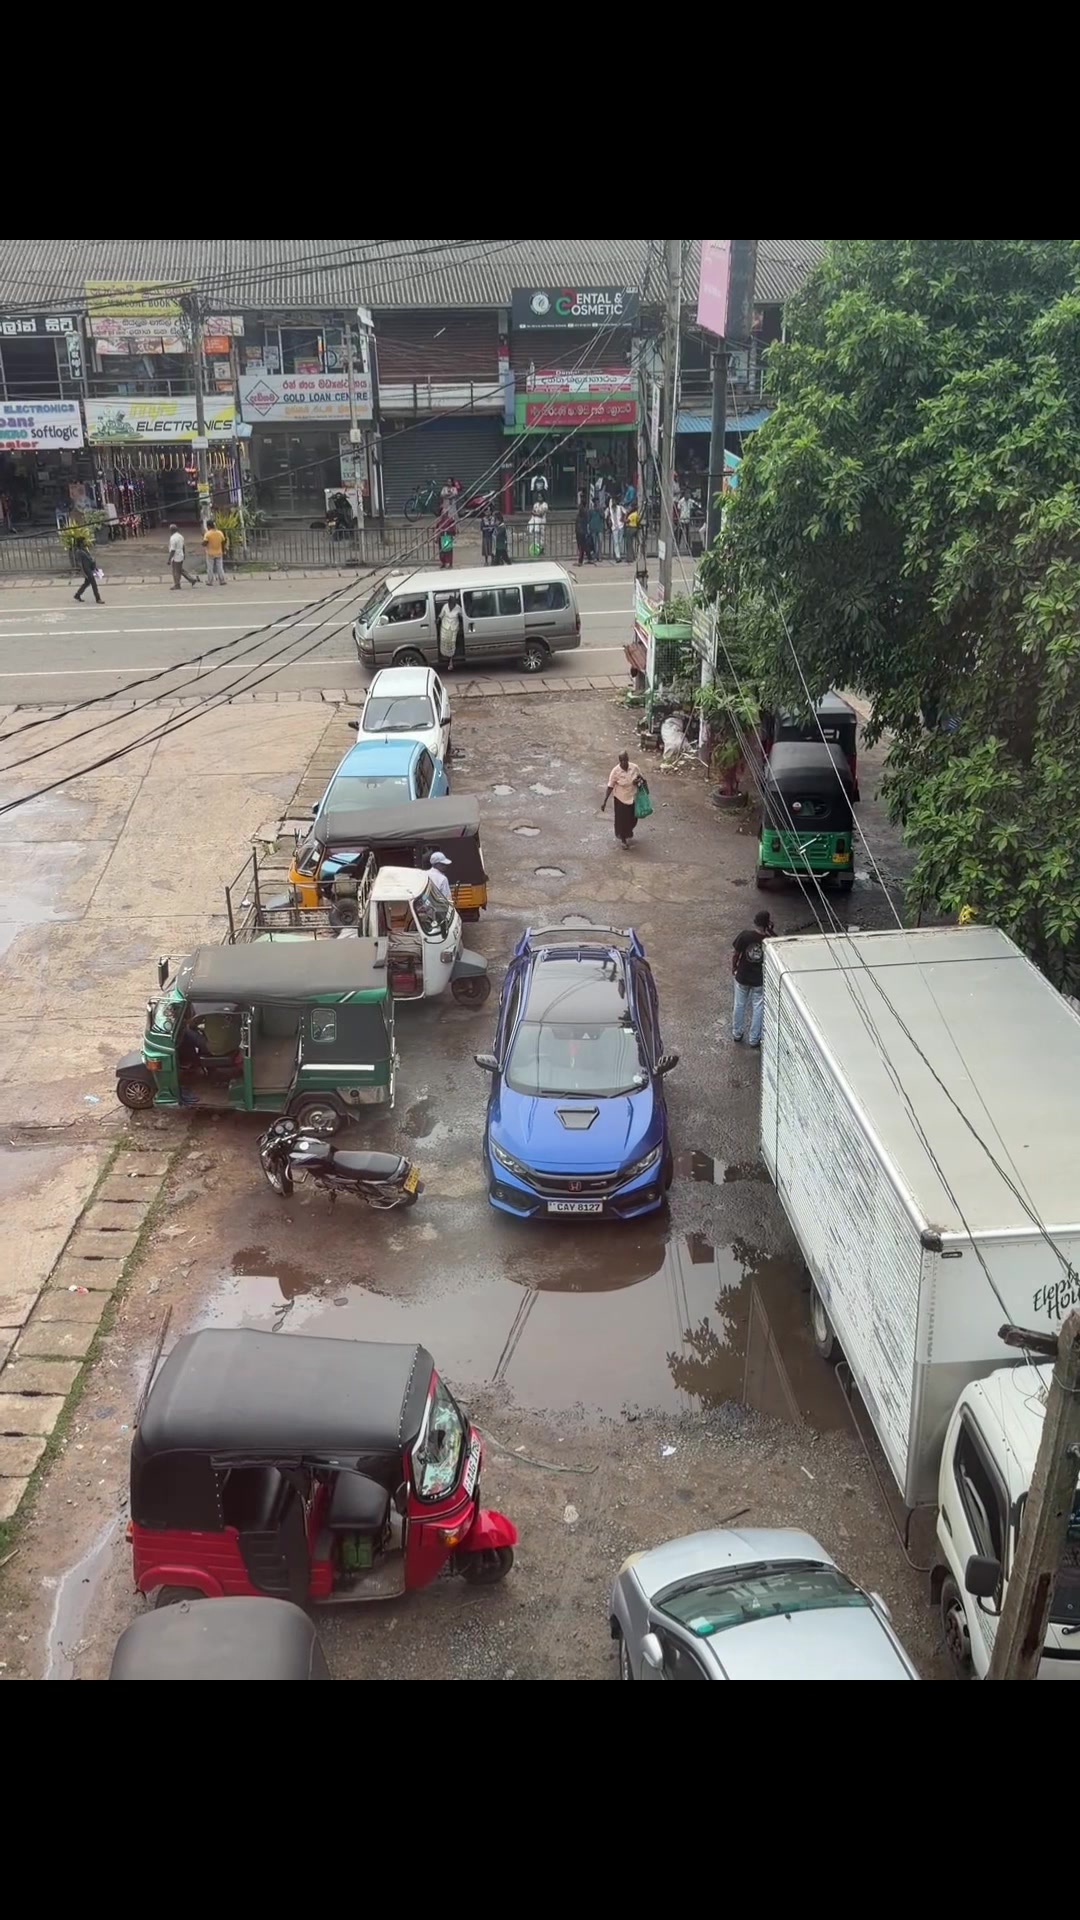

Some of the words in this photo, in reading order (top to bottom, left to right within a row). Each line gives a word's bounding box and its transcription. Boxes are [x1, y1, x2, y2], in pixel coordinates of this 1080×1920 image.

[283, 393, 306, 403] GOLD
[309, 392, 332, 402] LOAN
[334, 391, 368, 402] CENRE
[4, 403, 75, 414] ELECTRONICS
[31, 425, 79, 441] softlogic
[557, 1203, 575, 1211] CAY
[577, 1203, 600, 1211] 8127
